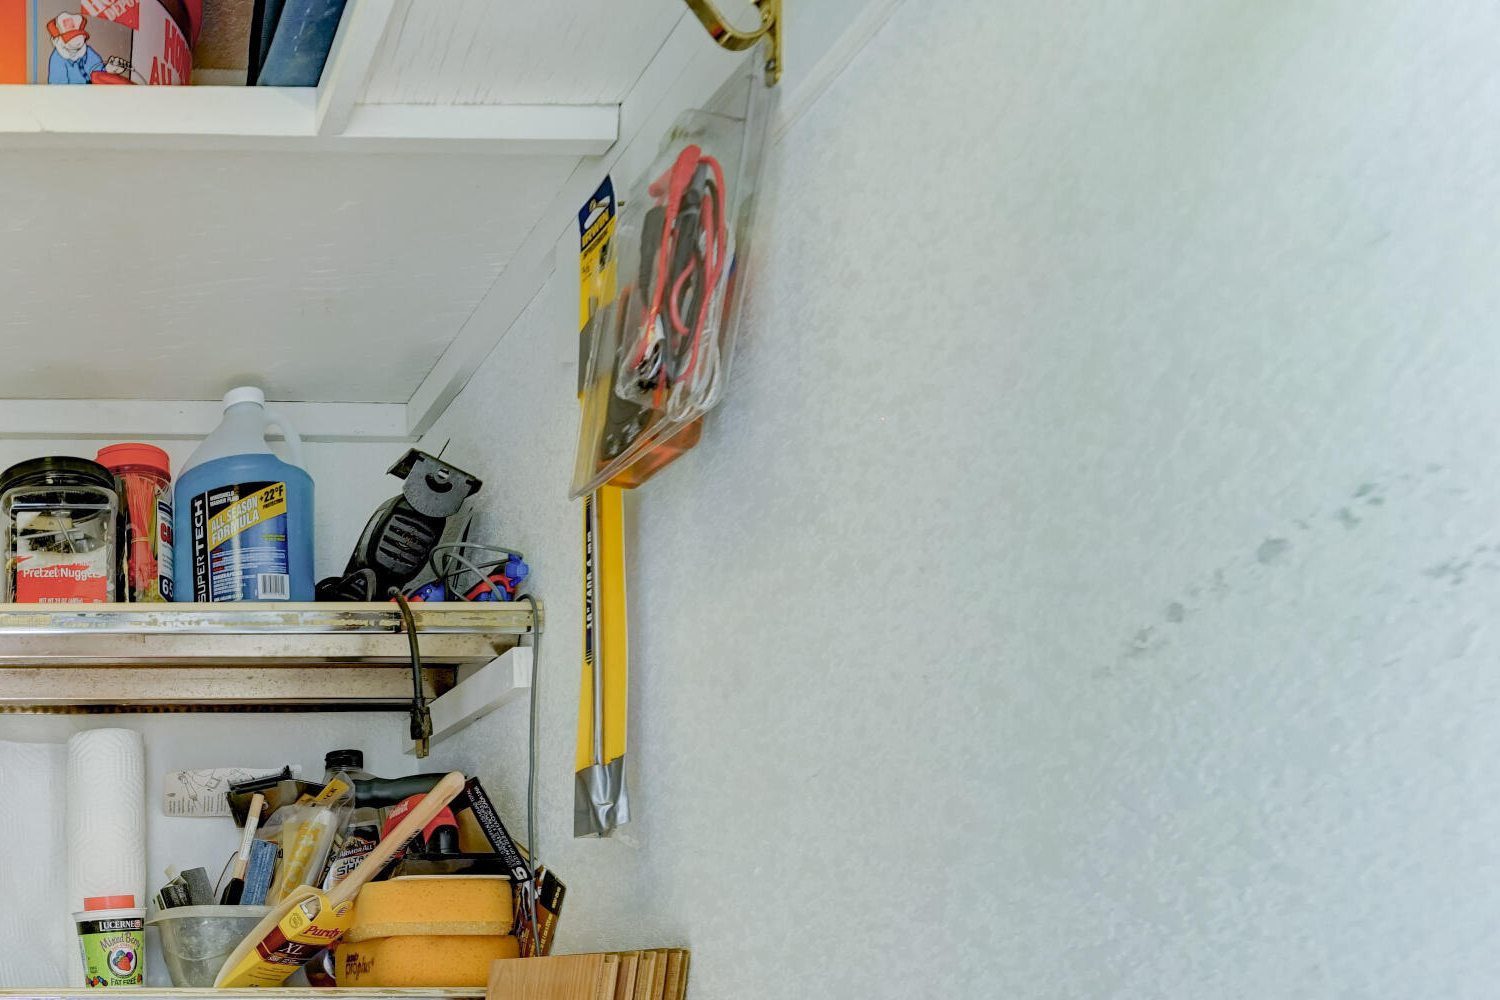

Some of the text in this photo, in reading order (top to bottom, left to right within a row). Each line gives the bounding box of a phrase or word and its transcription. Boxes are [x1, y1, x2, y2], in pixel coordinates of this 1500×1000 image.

[211, 496, 258, 534] ALL SEASON
[212, 509, 260, 546] FORMULA
[23, 567, 57, 578] Pretzel
[99, 920, 134, 931] LUCERNE
[100, 932, 124, 952] Mixed
[281, 943, 306, 956] XL
